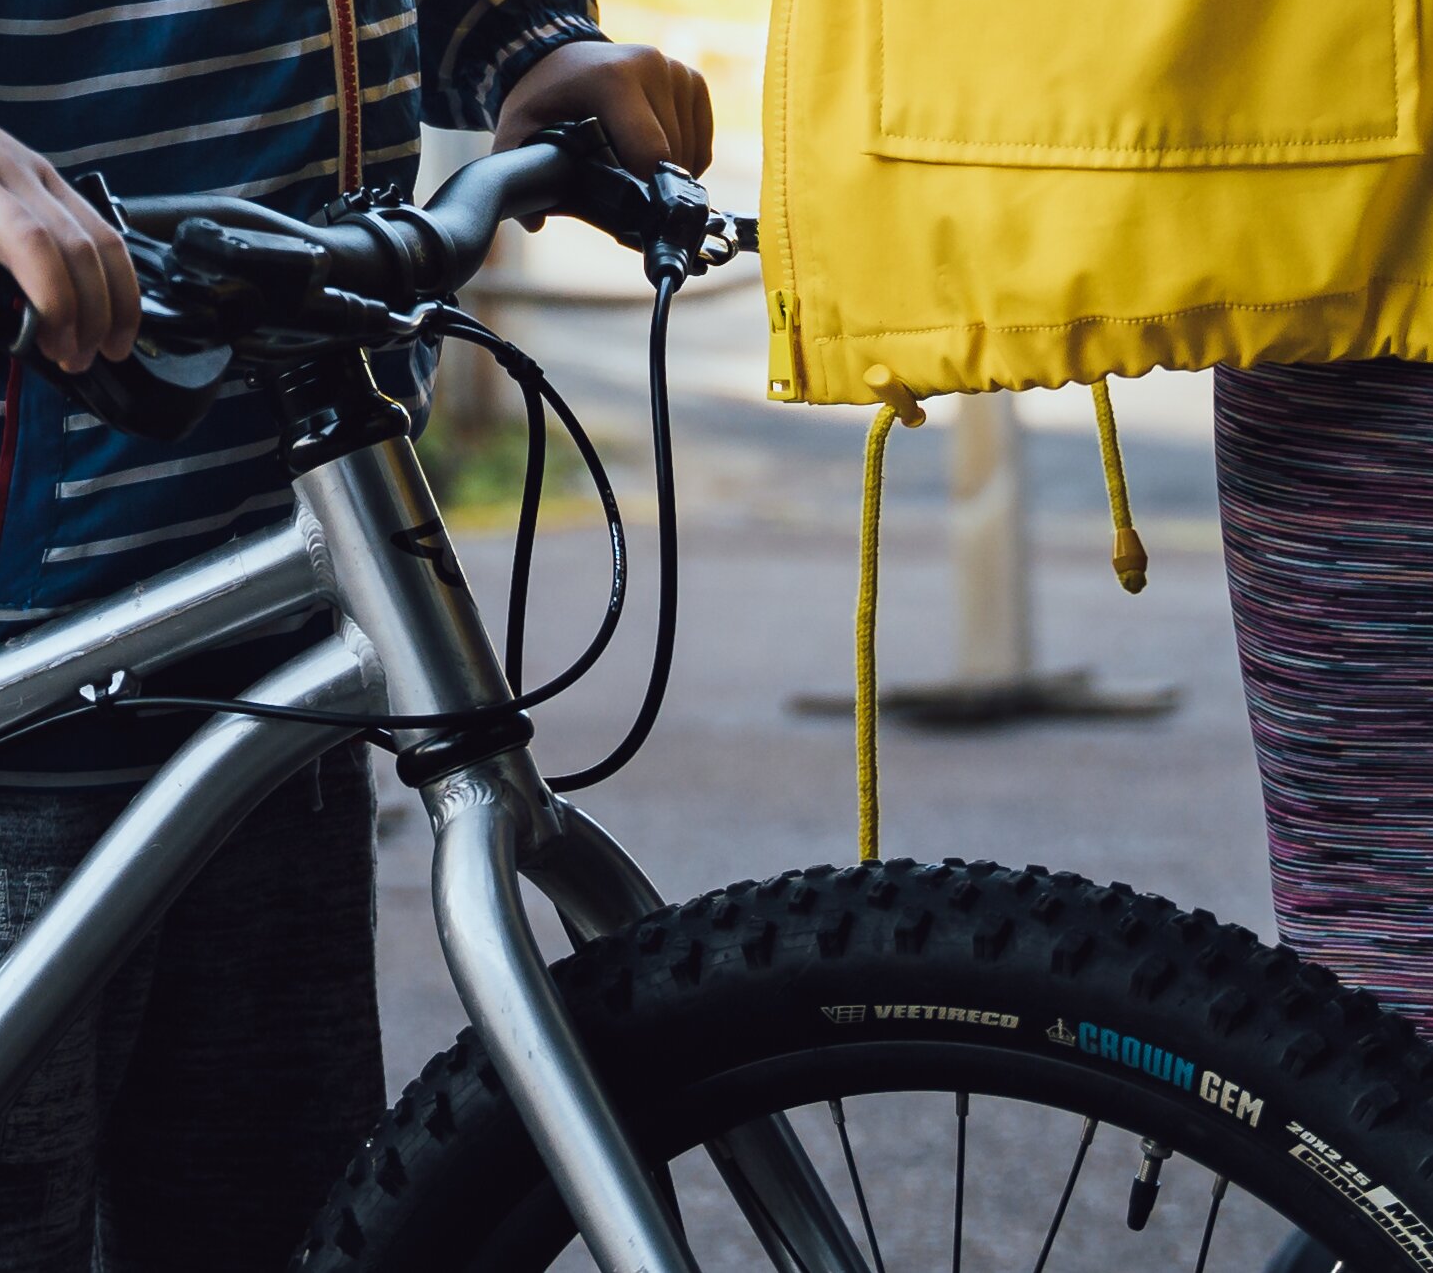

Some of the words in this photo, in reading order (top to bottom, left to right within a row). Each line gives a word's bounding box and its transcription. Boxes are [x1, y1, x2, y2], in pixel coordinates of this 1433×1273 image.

[874, 1005, 1019, 1029] VEETIRECO
[1078, 1022, 1195, 1092] CROWN
[1199, 1070, 1265, 1129] GEM
